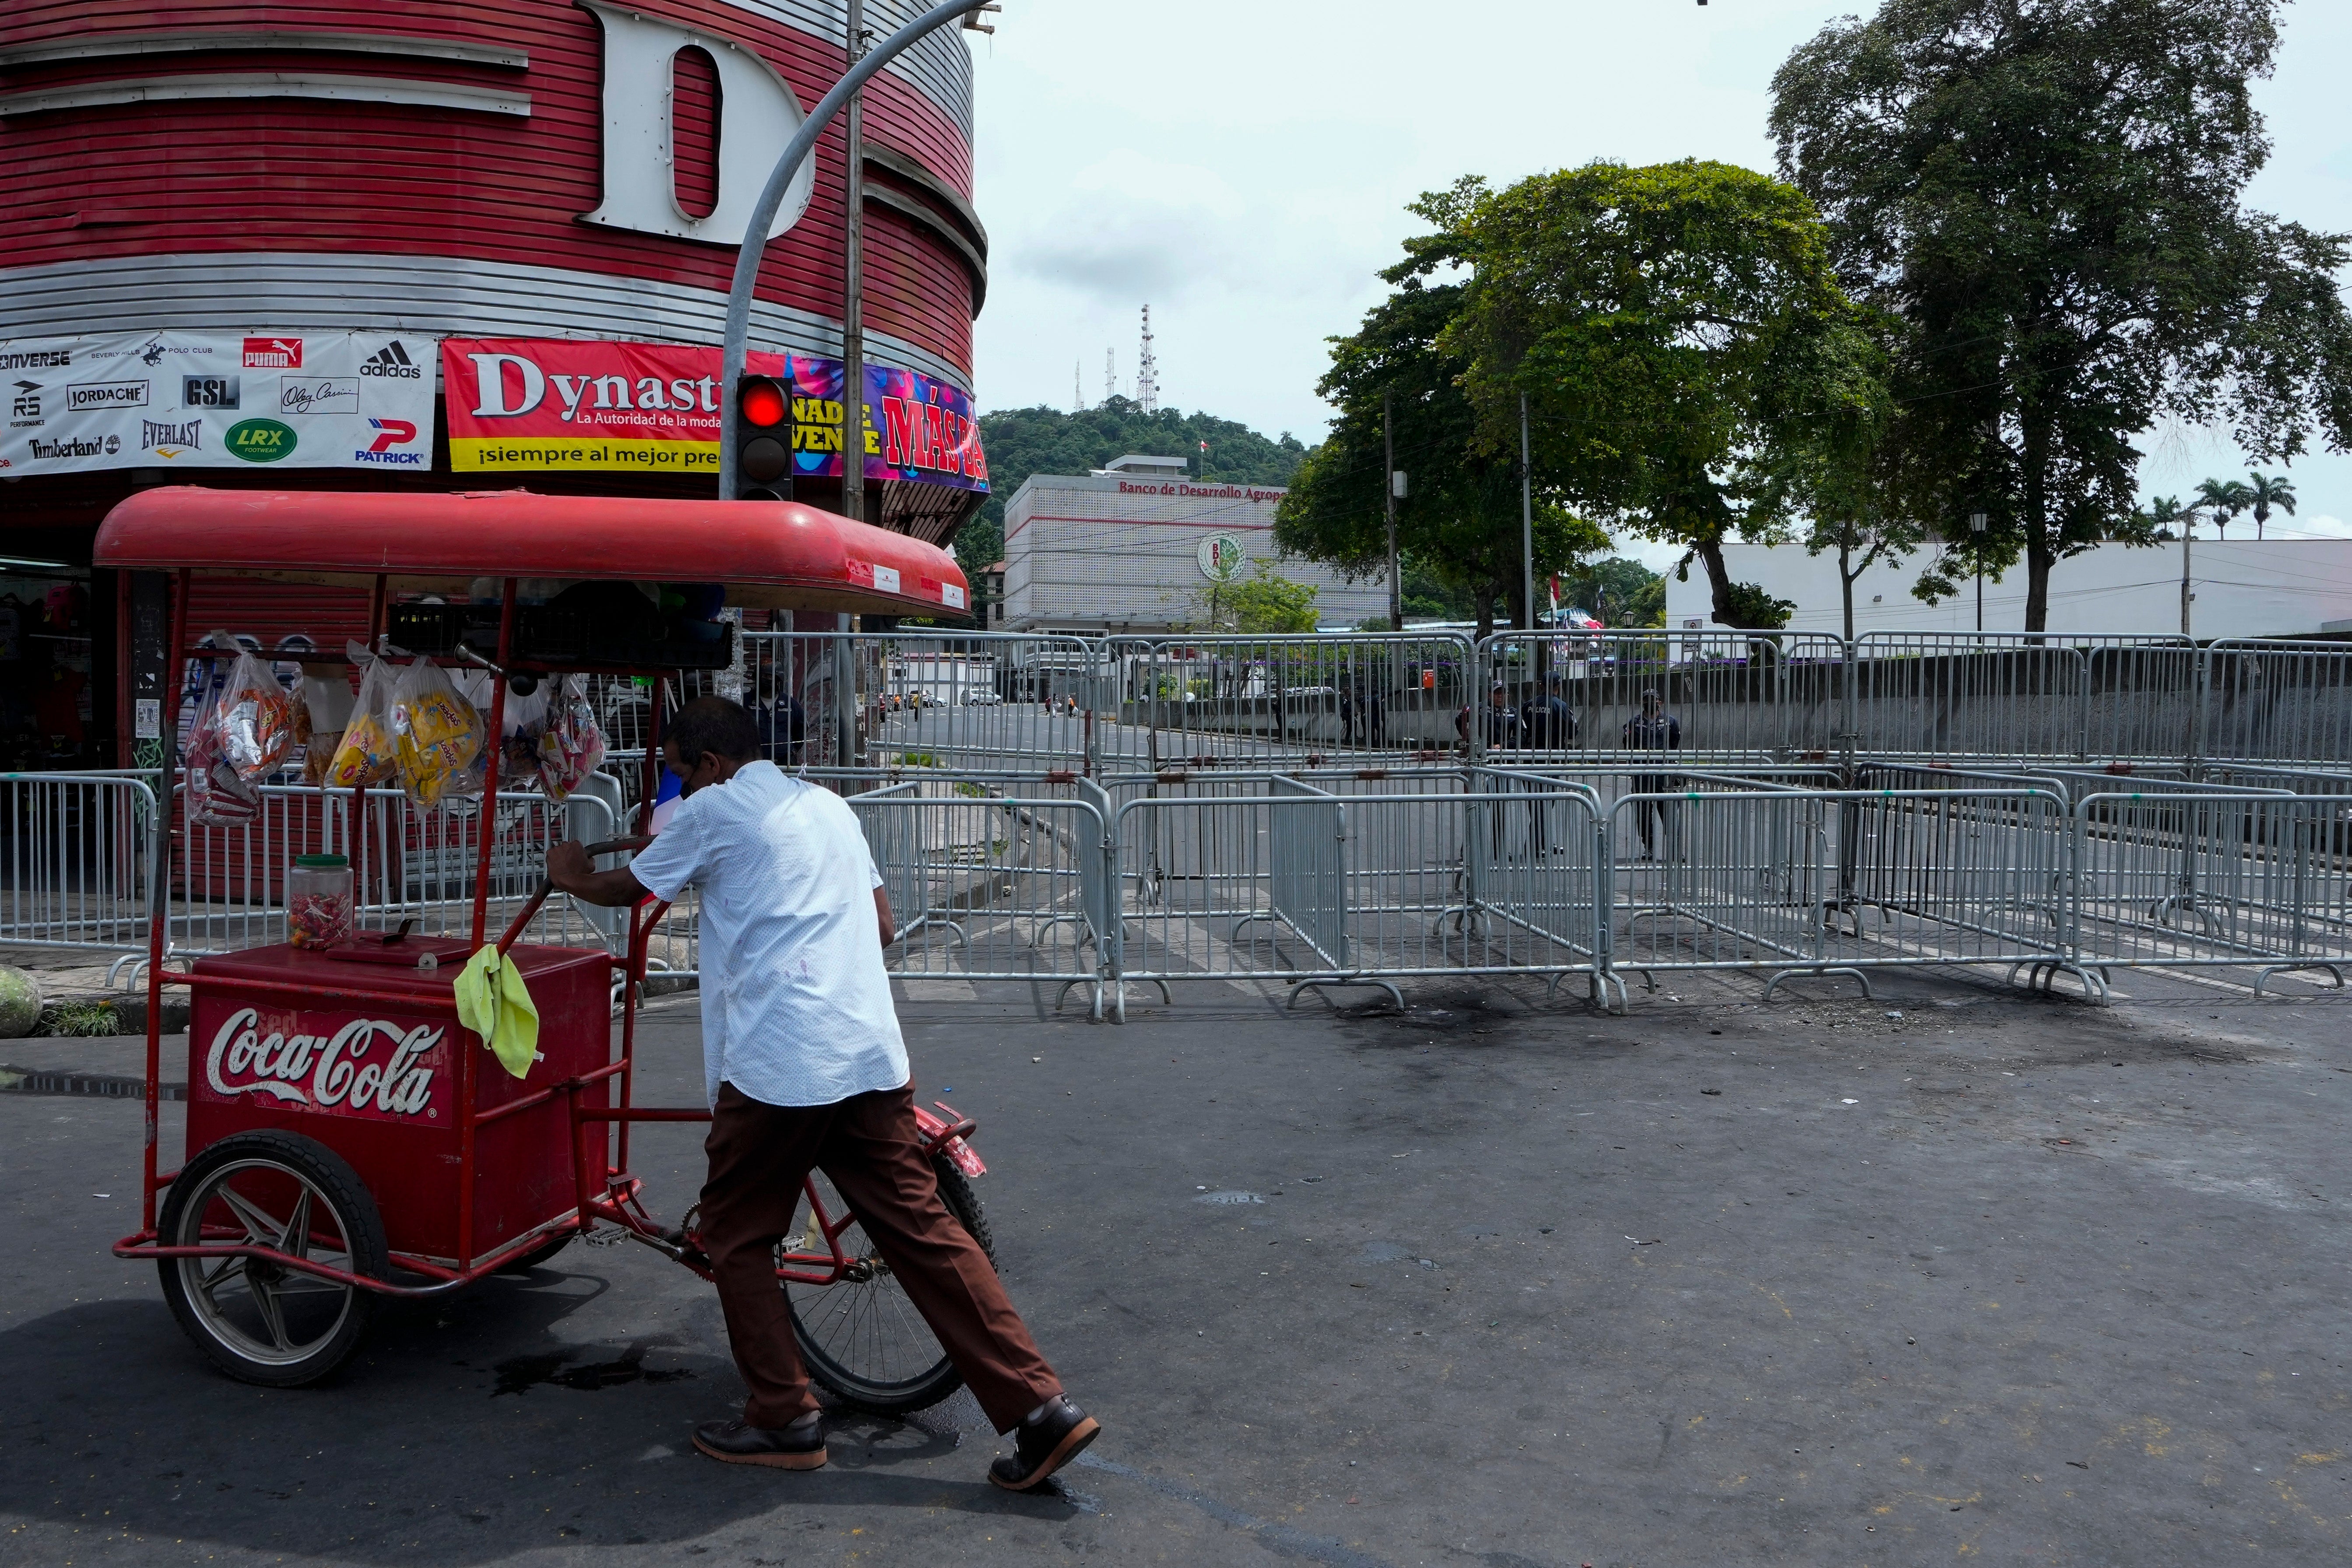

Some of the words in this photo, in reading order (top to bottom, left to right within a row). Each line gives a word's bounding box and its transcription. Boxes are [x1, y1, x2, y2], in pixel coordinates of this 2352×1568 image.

[573, 0, 815, 245] D
[245, 352, 288, 367] PUMA
[359, 363, 421, 379] adidas
[72, 387, 141, 407] JORDACHE
[187, 380, 235, 405] GSL
[282, 386, 315, 412] Oleg
[316, 382, 358, 400] Cassini
[467, 353, 722, 422] Dynast
[10, 419, 45, 428] PERFORMANCE
[577, 412, 591, 424] La
[594, 412, 656, 425] Autoridad
[659, 414, 674, 426] de
[677, 415, 687, 426] la
[689, 416, 721, 428] moda
[792, 398, 872, 428] NADE
[141, 418, 202, 451] EVERLAST
[236, 429, 284, 446] LRX
[792, 425, 880, 454] VENE
[881, 385, 960, 475] MÁS
[29, 436, 103, 459] Timberland
[355, 450, 420, 464] PATRICK
[590, 446, 608, 461] al
[616, 447, 679, 466] mejor
[685, 452, 720, 467] pre
[1119, 481, 1157, 494] Banco
[1161, 483, 1175, 495] de
[1179, 484, 1241, 498] Desarrollo
[207, 1007, 445, 1115] Coca-Cola
